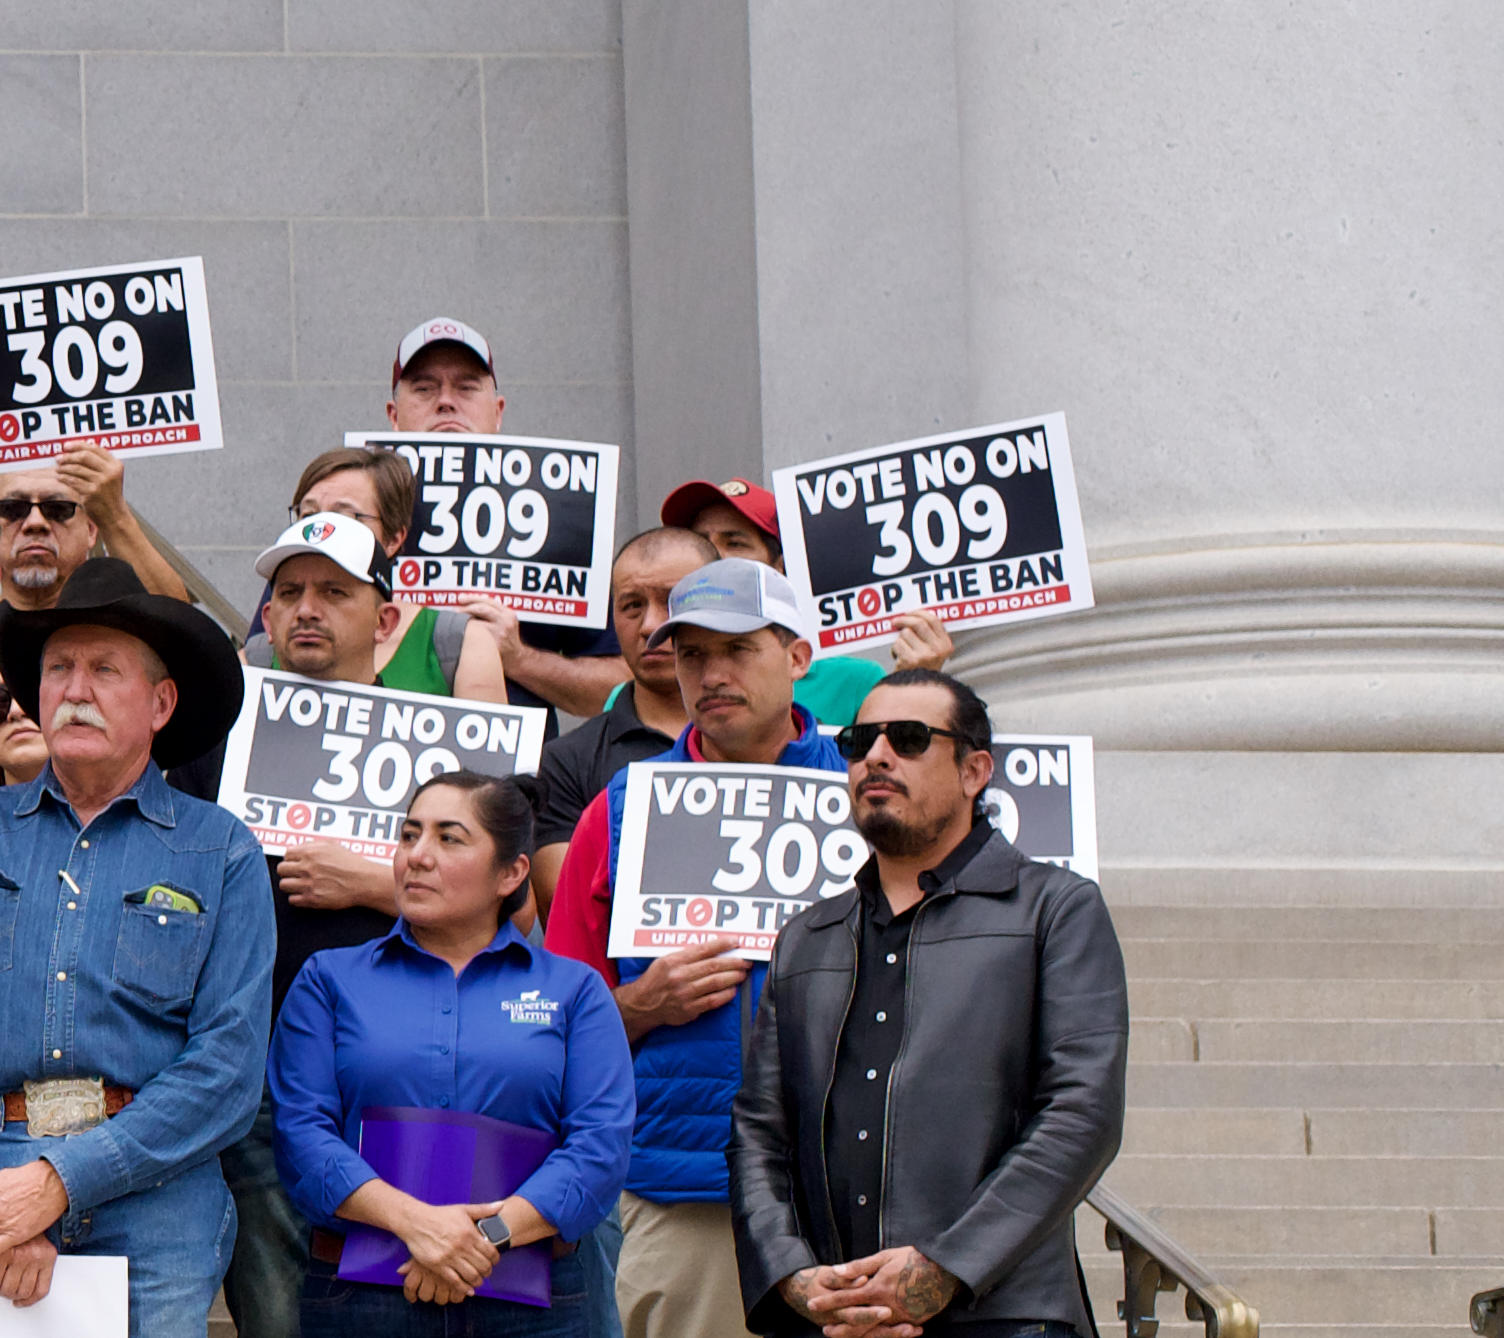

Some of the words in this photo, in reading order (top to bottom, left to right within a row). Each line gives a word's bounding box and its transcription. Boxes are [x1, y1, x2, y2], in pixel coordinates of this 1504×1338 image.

[55, 281, 114, 323] NO
[125, 273, 184, 315] ON
[430, 324, 457, 335] CO
[8, 321, 143, 403] 309
[51, 402, 116, 436] THE
[124, 392, 195, 427] BAN
[99, 428, 187, 448] APPROACH
[475, 449, 530, 486] NO
[541, 453, 596, 490] ON
[796, 459, 906, 513] VOTE
[913, 446, 975, 492] NO
[985, 430, 1048, 476] ON
[419, 485, 548, 558] 309
[866, 484, 1007, 576] 309
[452, 561, 512, 591] THE
[521, 565, 587, 596] BAN
[912, 568, 981, 606] THE
[989, 552, 1064, 593] BAN
[492, 597, 575, 611] APPROACH
[964, 590, 1056, 617] APPROACH
[261, 686, 374, 734] VOTE
[382, 703, 445, 743] NO
[456, 714, 519, 754] ON
[1006, 750, 1068, 784] ON
[652, 776, 772, 817] VOTE
[501, 1000, 559, 1012] Superior
